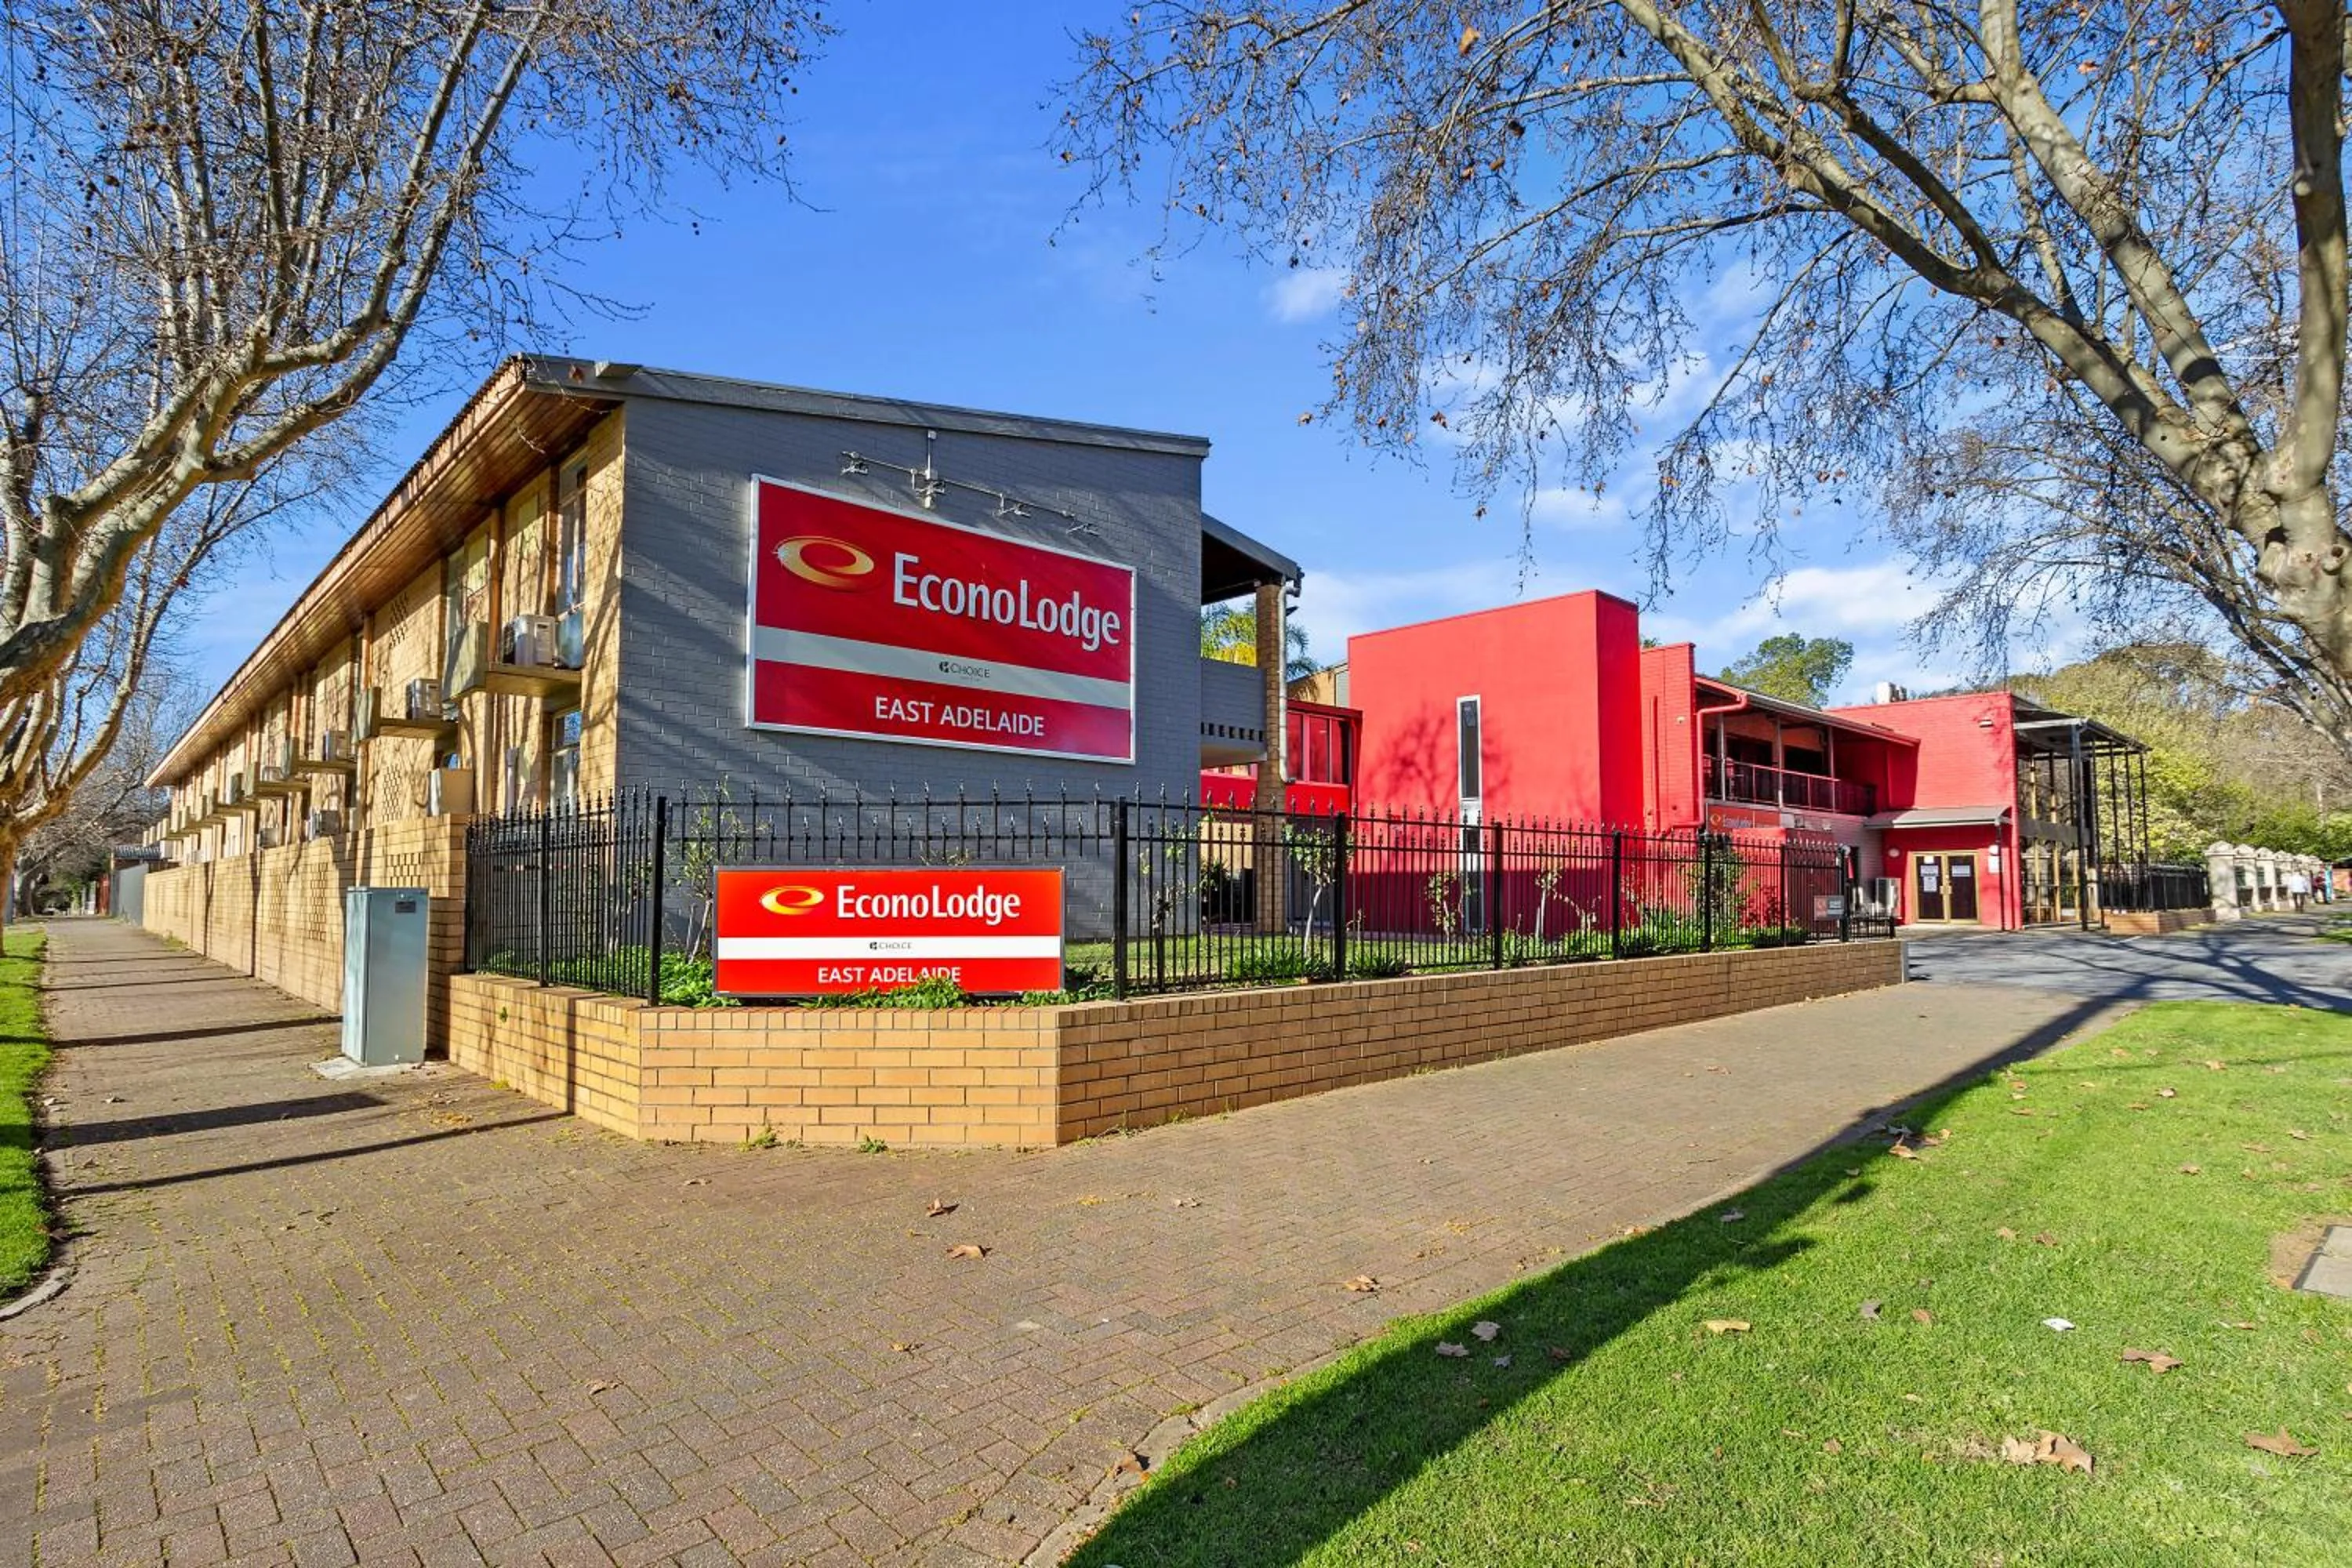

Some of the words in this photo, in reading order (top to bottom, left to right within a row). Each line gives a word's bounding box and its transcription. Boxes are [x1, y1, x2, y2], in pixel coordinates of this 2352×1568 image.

[893, 552, 1120, 652] EconoLodge
[950, 662, 990, 678] CHOICE
[876, 697, 935, 724] EAST
[940, 705, 1044, 735] ADELAIDE
[837, 885, 1020, 926] EconoLodge
[818, 967, 865, 983] EAST
